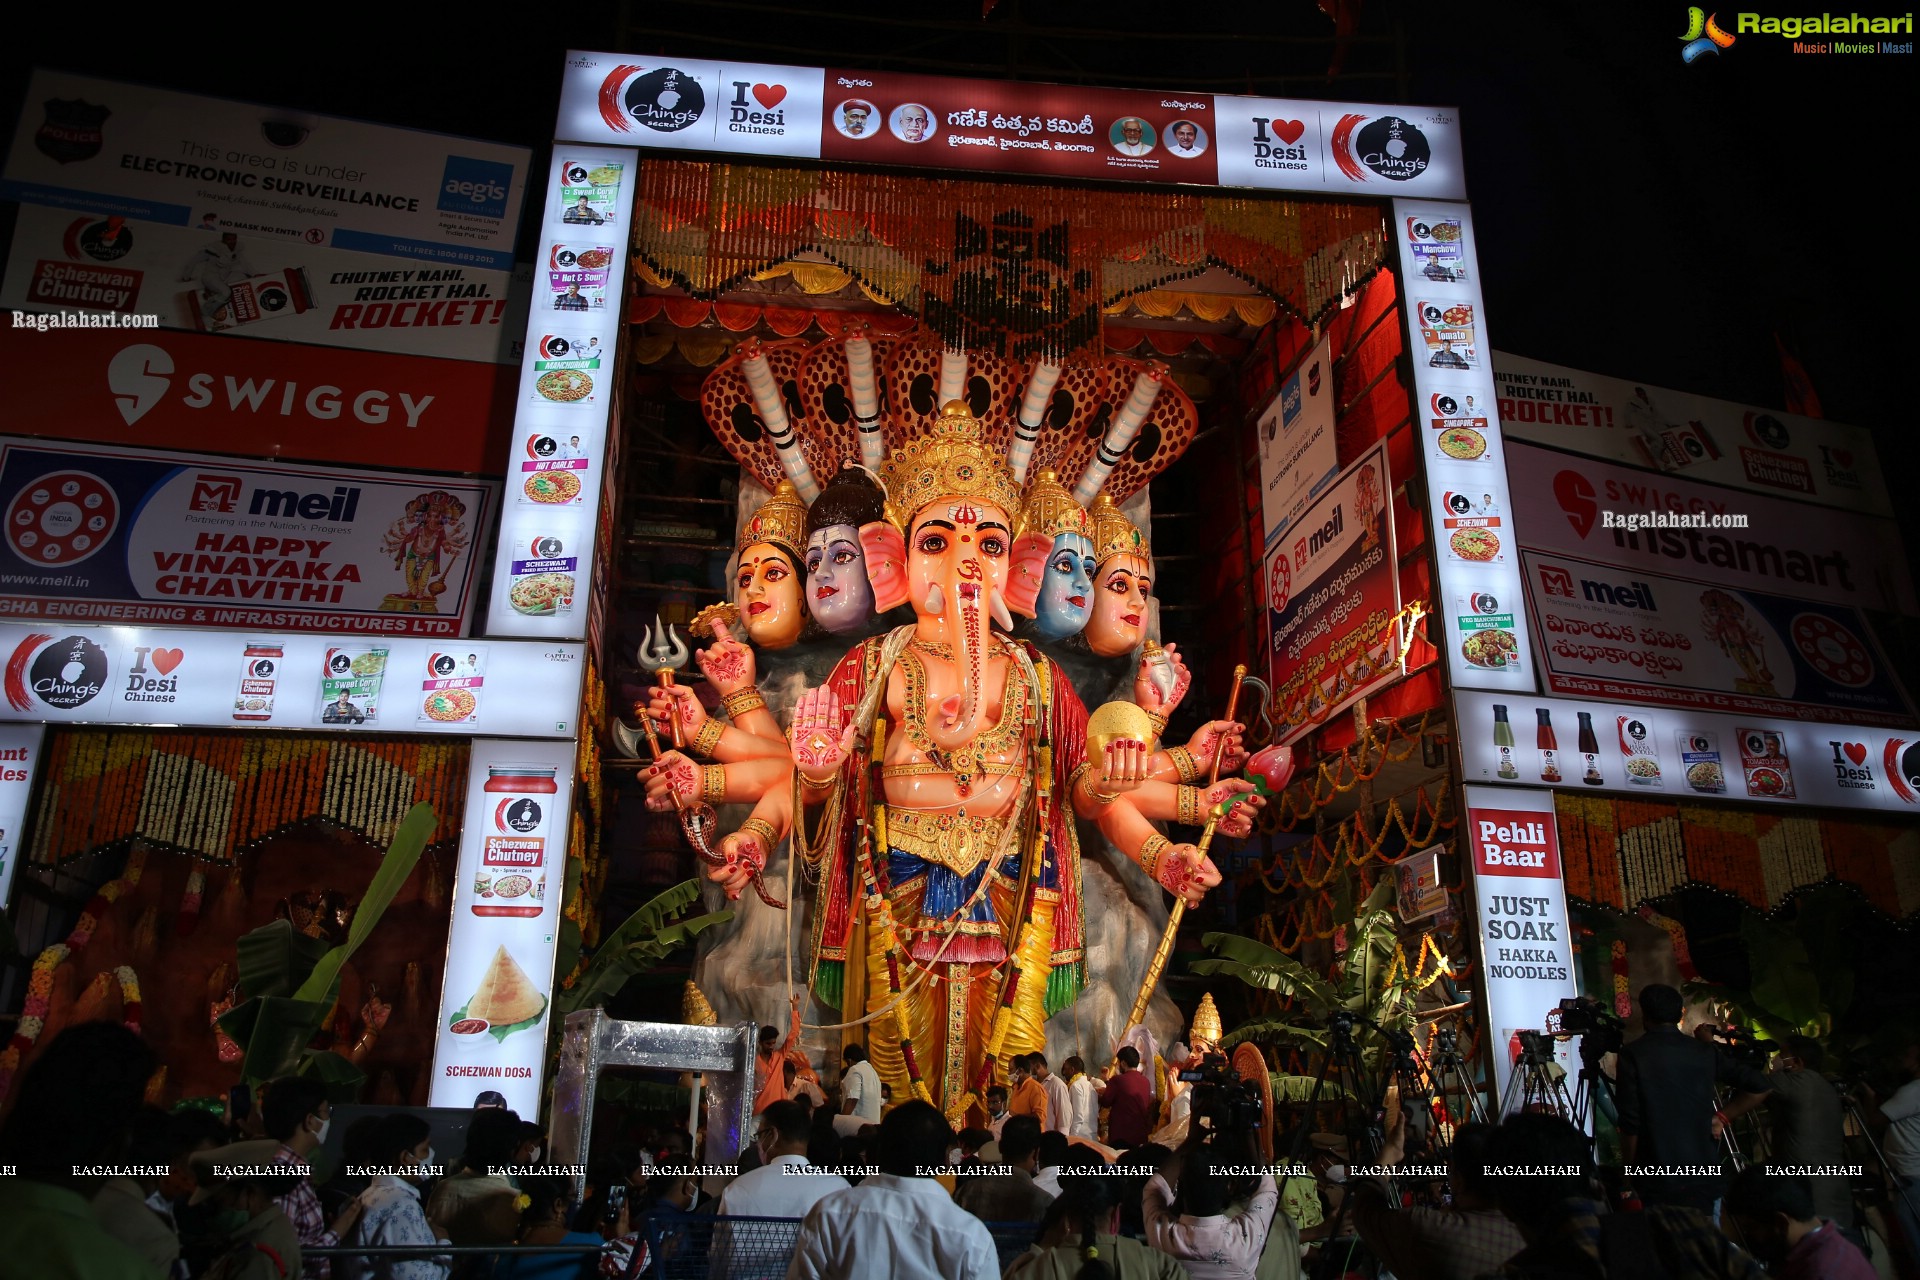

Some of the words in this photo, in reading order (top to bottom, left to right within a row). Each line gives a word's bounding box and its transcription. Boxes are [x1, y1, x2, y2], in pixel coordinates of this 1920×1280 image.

[630, 104, 698, 124] Ching's
[729, 107, 785, 126] Desi
[947, 108, 987, 128] గణేశ్
[991, 115, 1043, 137] ఉత్సవ
[1046, 114, 1094, 135] కమిటీ
[43, 124, 101, 142] POLICE
[728, 124, 785, 136] Chinese
[181, 140, 218, 161] This
[226, 149, 276, 169] area
[284, 153, 298, 173] is
[304, 159, 367, 183] under
[1254, 144, 1305, 161] Desi
[1255, 160, 1308, 171] Chinese
[1363, 153, 1426, 171] Ching's
[120, 154, 257, 189] ELECTRONIC
[262, 177, 419, 213] SURVEILLANCE
[445, 179, 505, 204] aegis
[573, 188, 595, 196] Sweet
[219, 219, 232, 228] NO
[234, 221, 258, 231] MASK
[261, 224, 273, 233] NO
[275, 227, 302, 238] ENTRY
[393, 243, 412, 254] TOLL
[1422, 244, 1456, 254] Manchow
[41, 263, 134, 287] Schezwan
[330, 270, 415, 285] CHUTNEY
[416, 269, 465, 282] NAHI.
[562, 273, 575, 282] Hot
[585, 273, 604, 282] Sour
[36, 278, 130, 308] Chutney
[354, 284, 443, 301] ROCKET
[446, 283, 490, 299] HAI.
[329, 299, 507, 331] ROCKET!
[1437, 331, 1466, 340] Tomato
[545, 360, 590, 370] MANCHURIAN
[183, 373, 435, 428] SWIGGY
[1506, 385, 1564, 402] ROCKET
[1567, 390, 1599, 405] HAI.
[1498, 398, 1614, 428] ROCKET!
[1443, 418, 1475, 428] SINGAPORE
[536, 460, 550, 470] HOT
[552, 460, 576, 469] GARLIC
[1745, 449, 1806, 473] Schezwan
[1747, 462, 1809, 491] Chutney
[249, 486, 361, 523] meil
[49, 513, 73, 523] INDIA
[185, 513, 235, 528] Partnering
[250, 518, 266, 528] the
[310, 524, 353, 535] Progress
[1456, 518, 1489, 528] SCHEZWAN
[1309, 502, 1344, 558] meil
[195, 531, 332, 558] HAPPY
[153, 551, 361, 584] VINAYAKA
[525, 559, 567, 568] SCHEZWAN
[0, 573, 90, 589] www.meil.in
[155, 574, 345, 604] CHAVITHI
[1581, 579, 1658, 612] meil
[49, 601, 187, 622] ENGINEERING
[192, 608, 206, 622] &
[213, 610, 408, 632] INFRASTRUCTURES
[412, 618, 455, 634] LTD.
[1545, 613, 1637, 644] వినాయక
[1640, 628, 1692, 651] చవితి
[544, 652, 576, 660] CAPITAL
[33, 678, 99, 699] Ching's
[126, 674, 177, 692] Desi
[242, 686, 272, 694] Chutney
[335, 679, 358, 689] Sweet
[360, 678, 377, 687] Corn
[434, 679, 448, 689] HOT
[449, 678, 472, 688] GARLIC
[124, 691, 176, 703] Chinese
[1834, 764, 1874, 781] Desi
[1838, 779, 1875, 790] Chinese
[1479, 820, 1547, 845] Pehli
[489, 838, 540, 850] Schezwan
[487, 848, 539, 865] Chutney
[1484, 844, 1546, 868] Baar
[1489, 896, 1550, 917] JUST
[1489, 920, 1557, 942] SOAK
[1499, 949, 1558, 964] HAKKA
[1490, 966, 1568, 981] NOODLES
[446, 1065, 502, 1079] SCHEZWAN
[505, 1066, 532, 1079] DOSA
